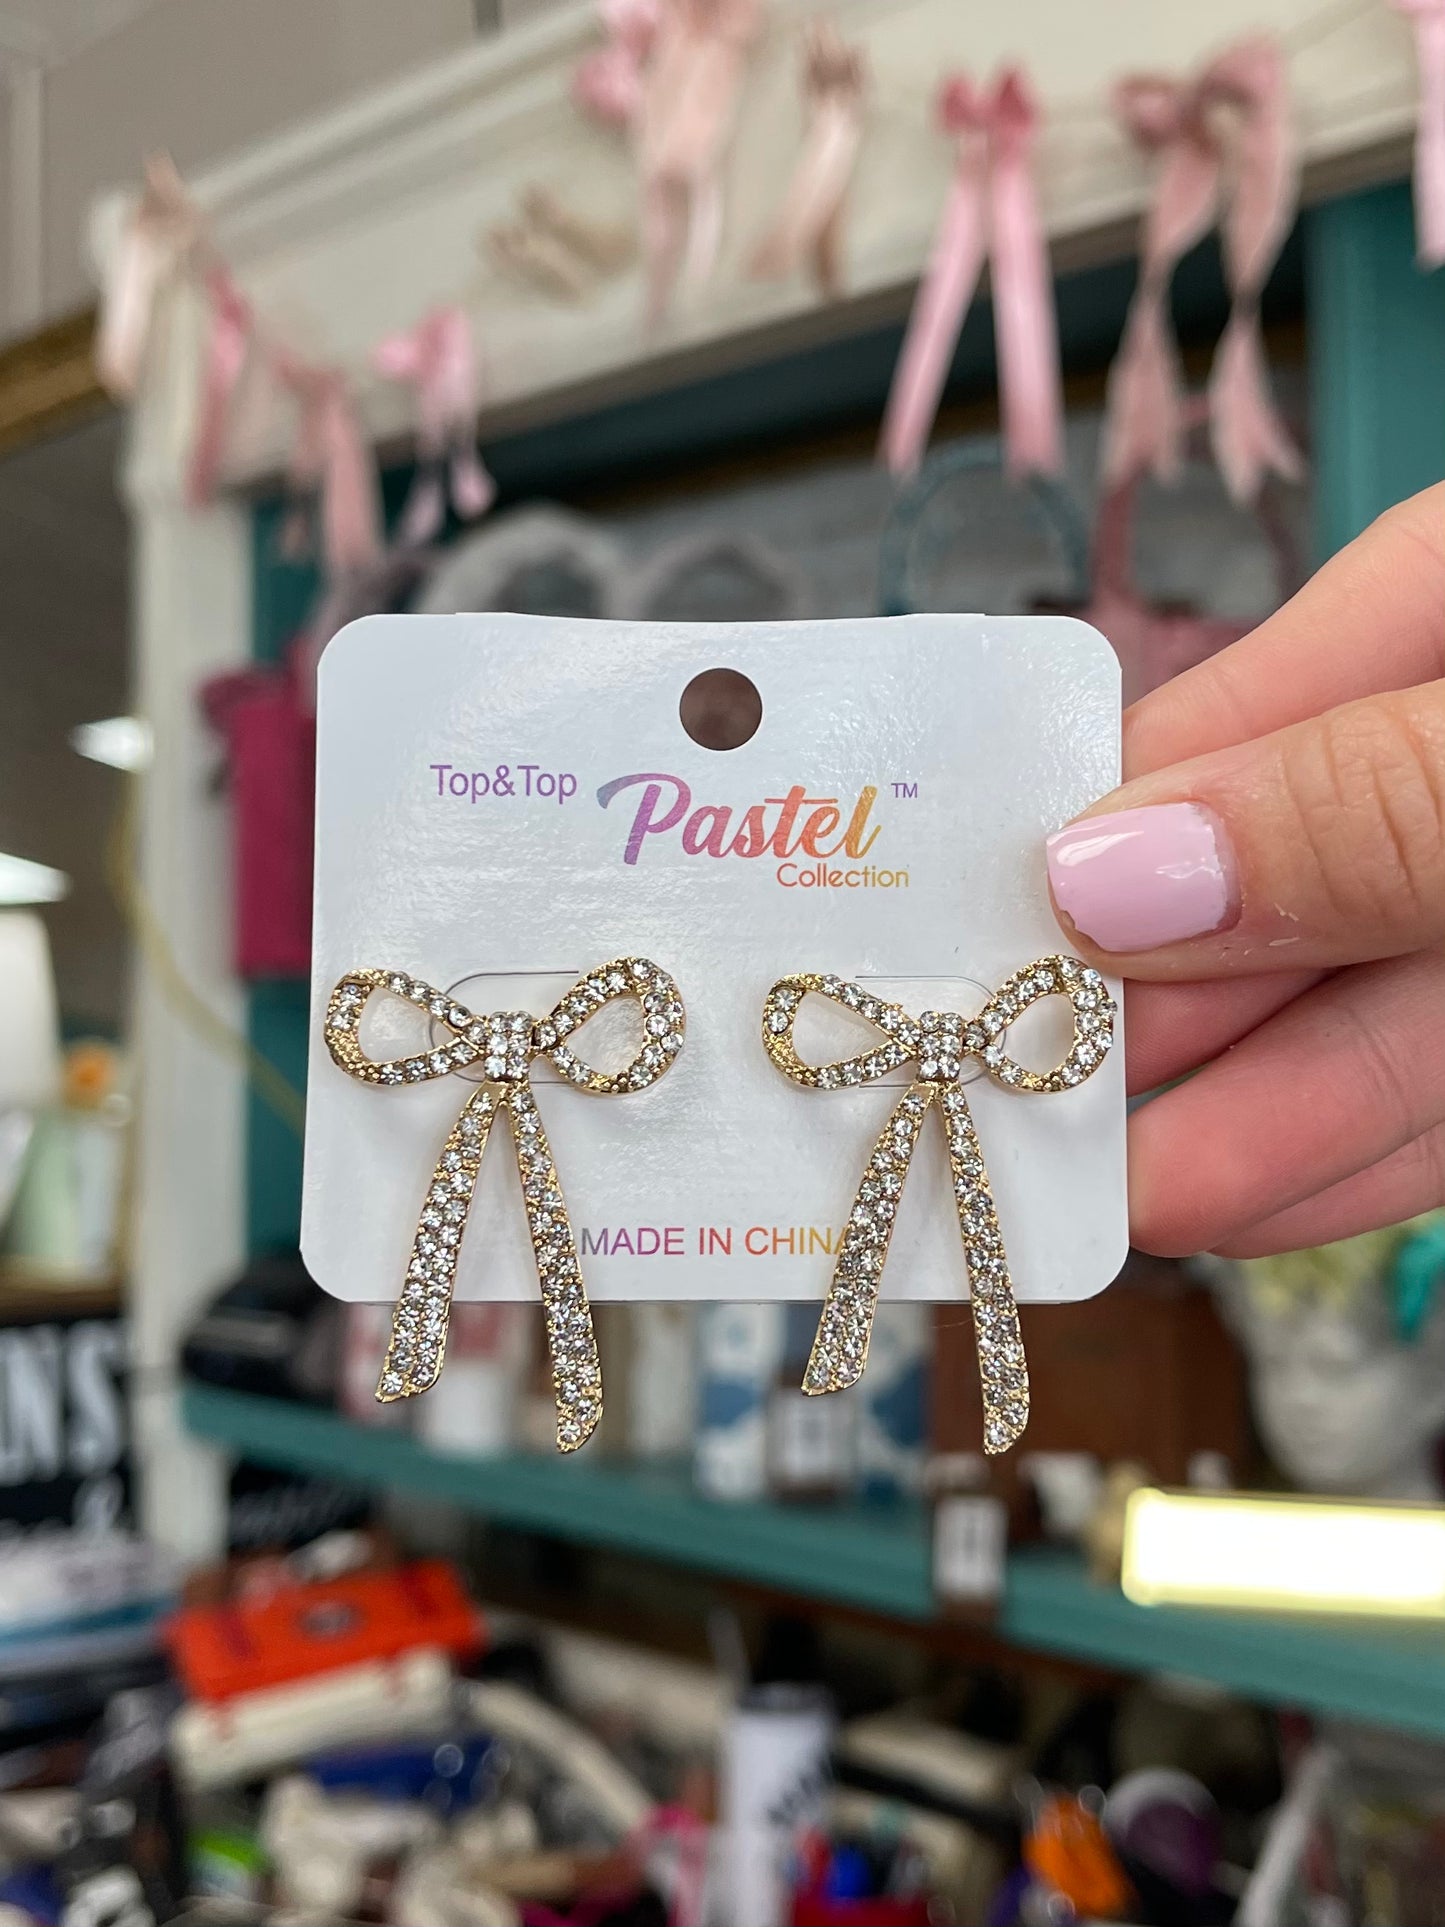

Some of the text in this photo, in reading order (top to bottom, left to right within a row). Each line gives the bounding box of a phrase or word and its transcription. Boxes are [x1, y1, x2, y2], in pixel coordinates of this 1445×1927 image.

[430, 764, 577, 804] Top&Top
[596, 772, 882, 866] Pastel
[776, 863, 909, 888] Collection
[580, 1226, 685, 1256] MADE
[699, 1226, 732, 1256] IN
